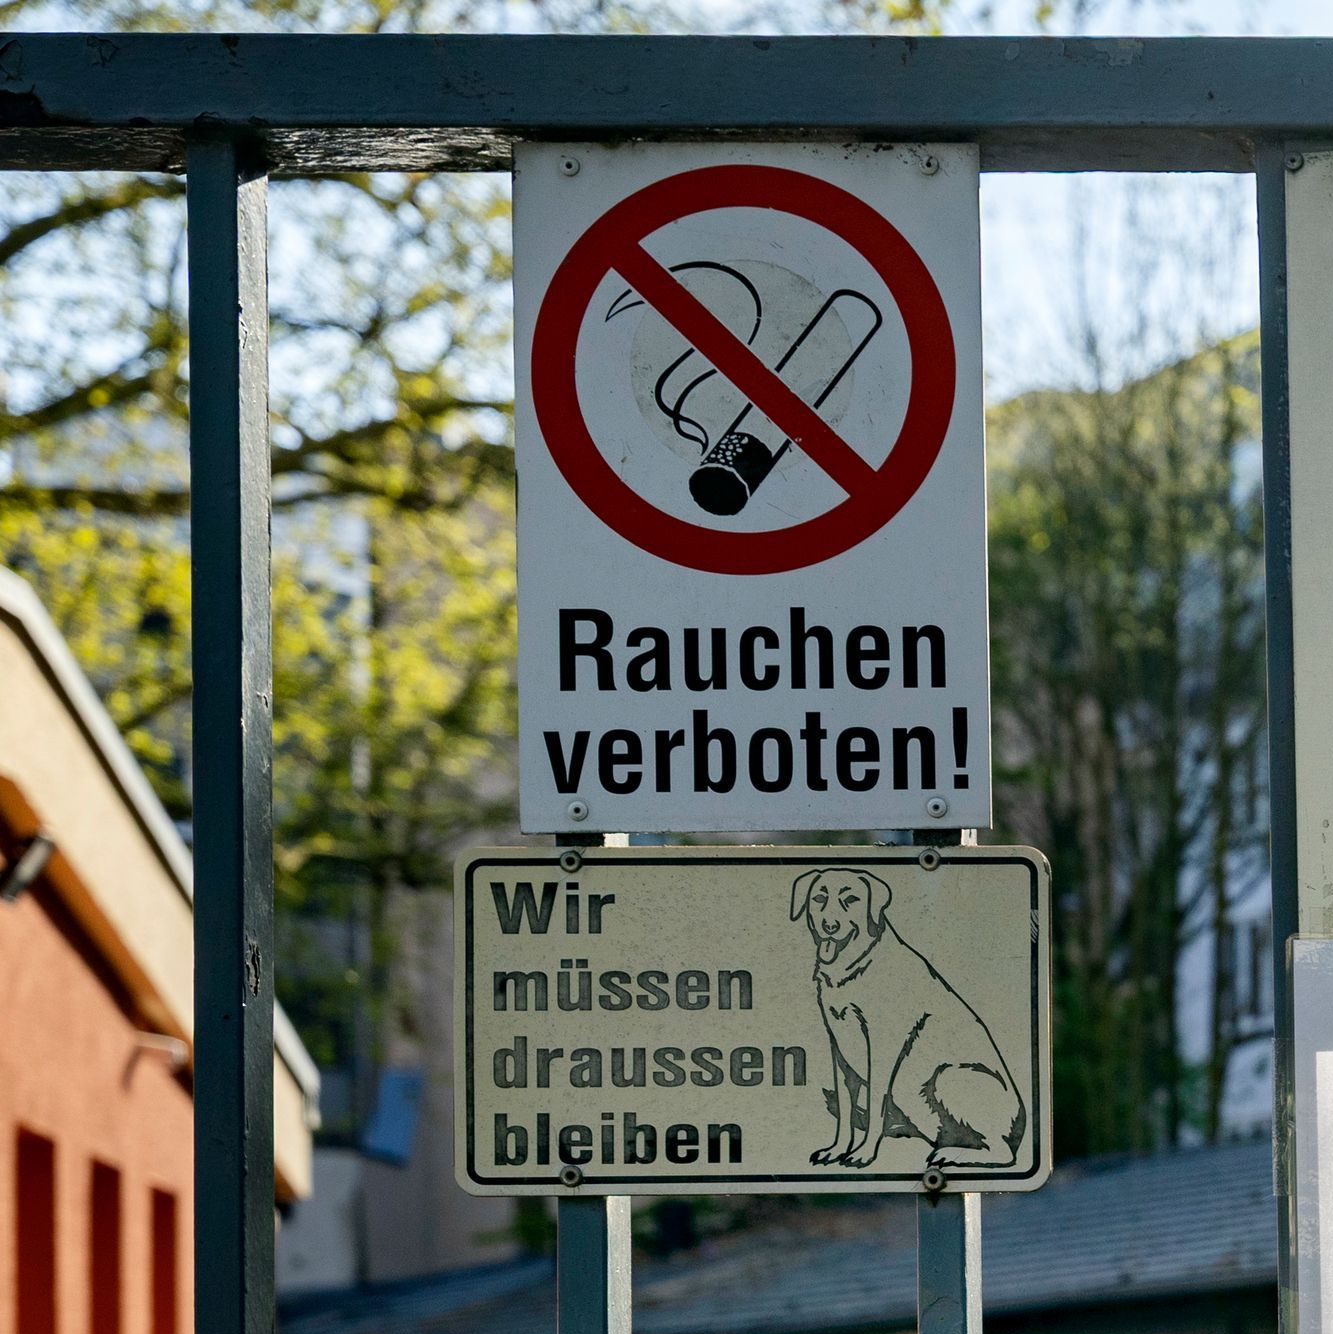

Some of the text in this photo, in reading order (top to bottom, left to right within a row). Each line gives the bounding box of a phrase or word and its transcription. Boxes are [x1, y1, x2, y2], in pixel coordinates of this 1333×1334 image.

[557, 606, 948, 693] Rauchen
[543, 706, 970, 795] verboten!
[489, 881, 616, 935] Wir
[492, 957, 754, 1012] müssen
[492, 1035, 808, 1090] draussen
[493, 1112, 743, 1167] bleiben
